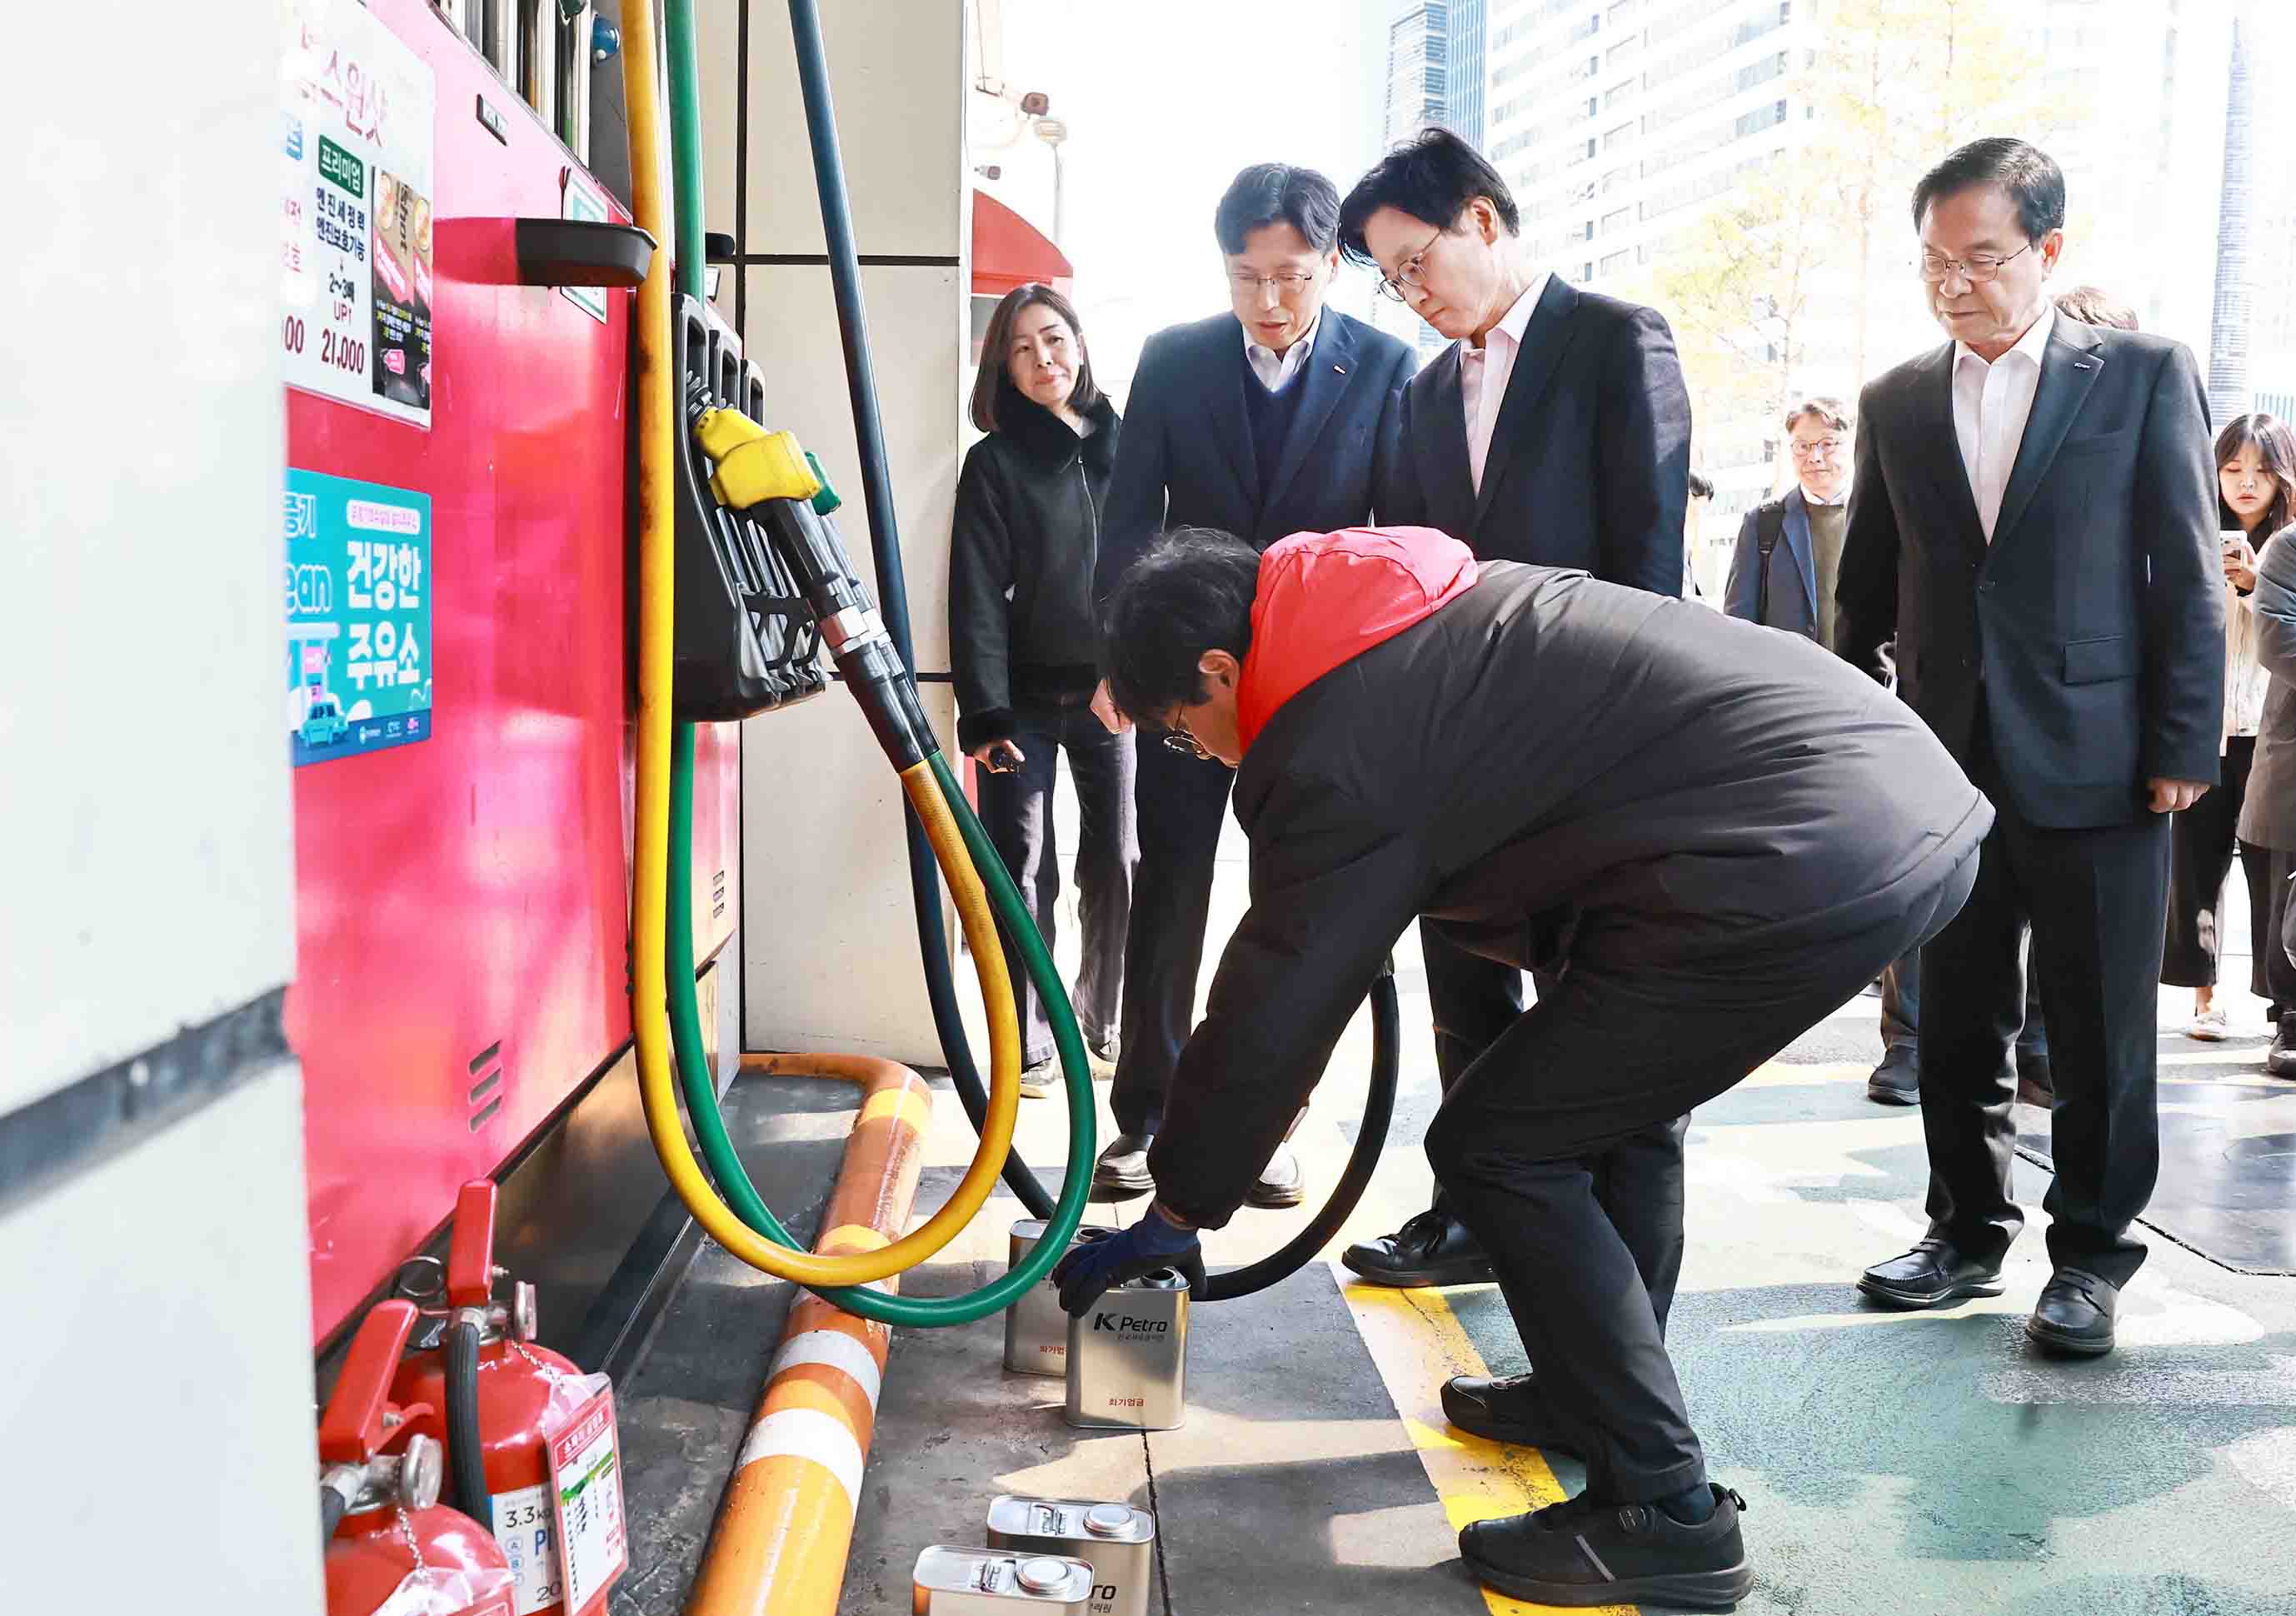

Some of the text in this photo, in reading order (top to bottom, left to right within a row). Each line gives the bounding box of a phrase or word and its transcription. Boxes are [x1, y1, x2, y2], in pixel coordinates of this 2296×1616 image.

[321, 144, 361, 192] 프리미엄
[281, 315, 304, 353] 00
[322, 327, 364, 374] 21,000
[347, 540, 421, 611] 건강한
[347, 621, 421, 691] 주유소
[1093, 1312, 1168, 1333] K Petro
[1040, 1345, 1067, 1355] 화기엄
[1108, 1399, 1145, 1407] 화기엄금
